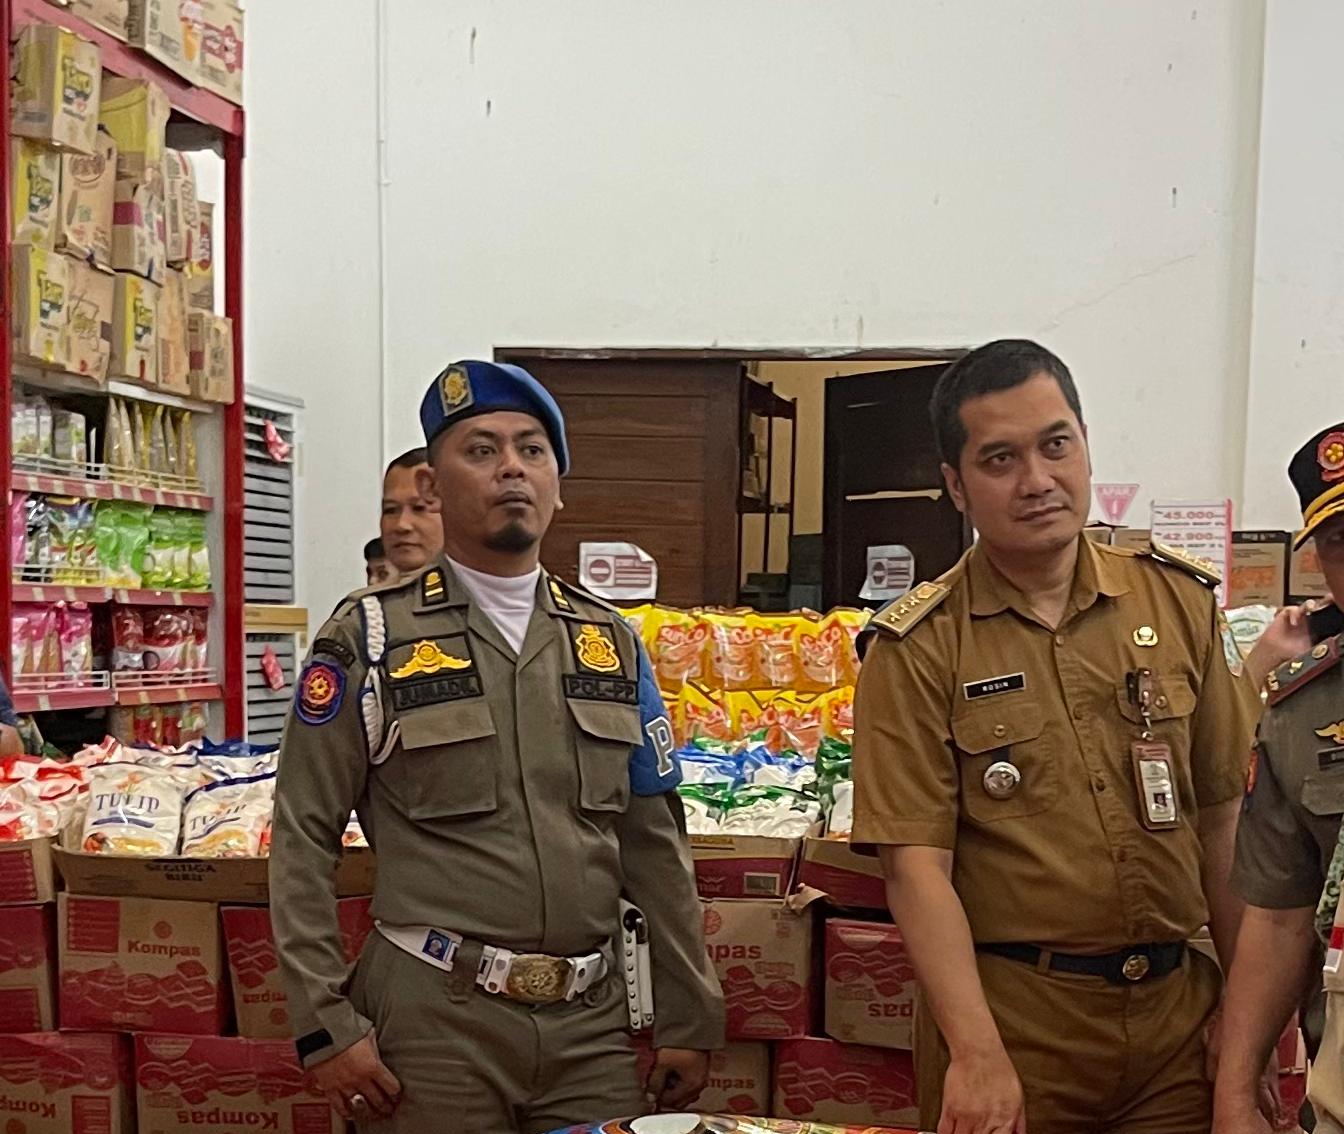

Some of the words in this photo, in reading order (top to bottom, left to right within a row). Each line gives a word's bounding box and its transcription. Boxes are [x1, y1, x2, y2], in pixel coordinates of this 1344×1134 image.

[569, 680, 634, 698] POL-PP
[96, 792, 160, 814] TULIP
[128, 940, 202, 959] Kompas
[177, 1109, 280, 1130] Kompas
